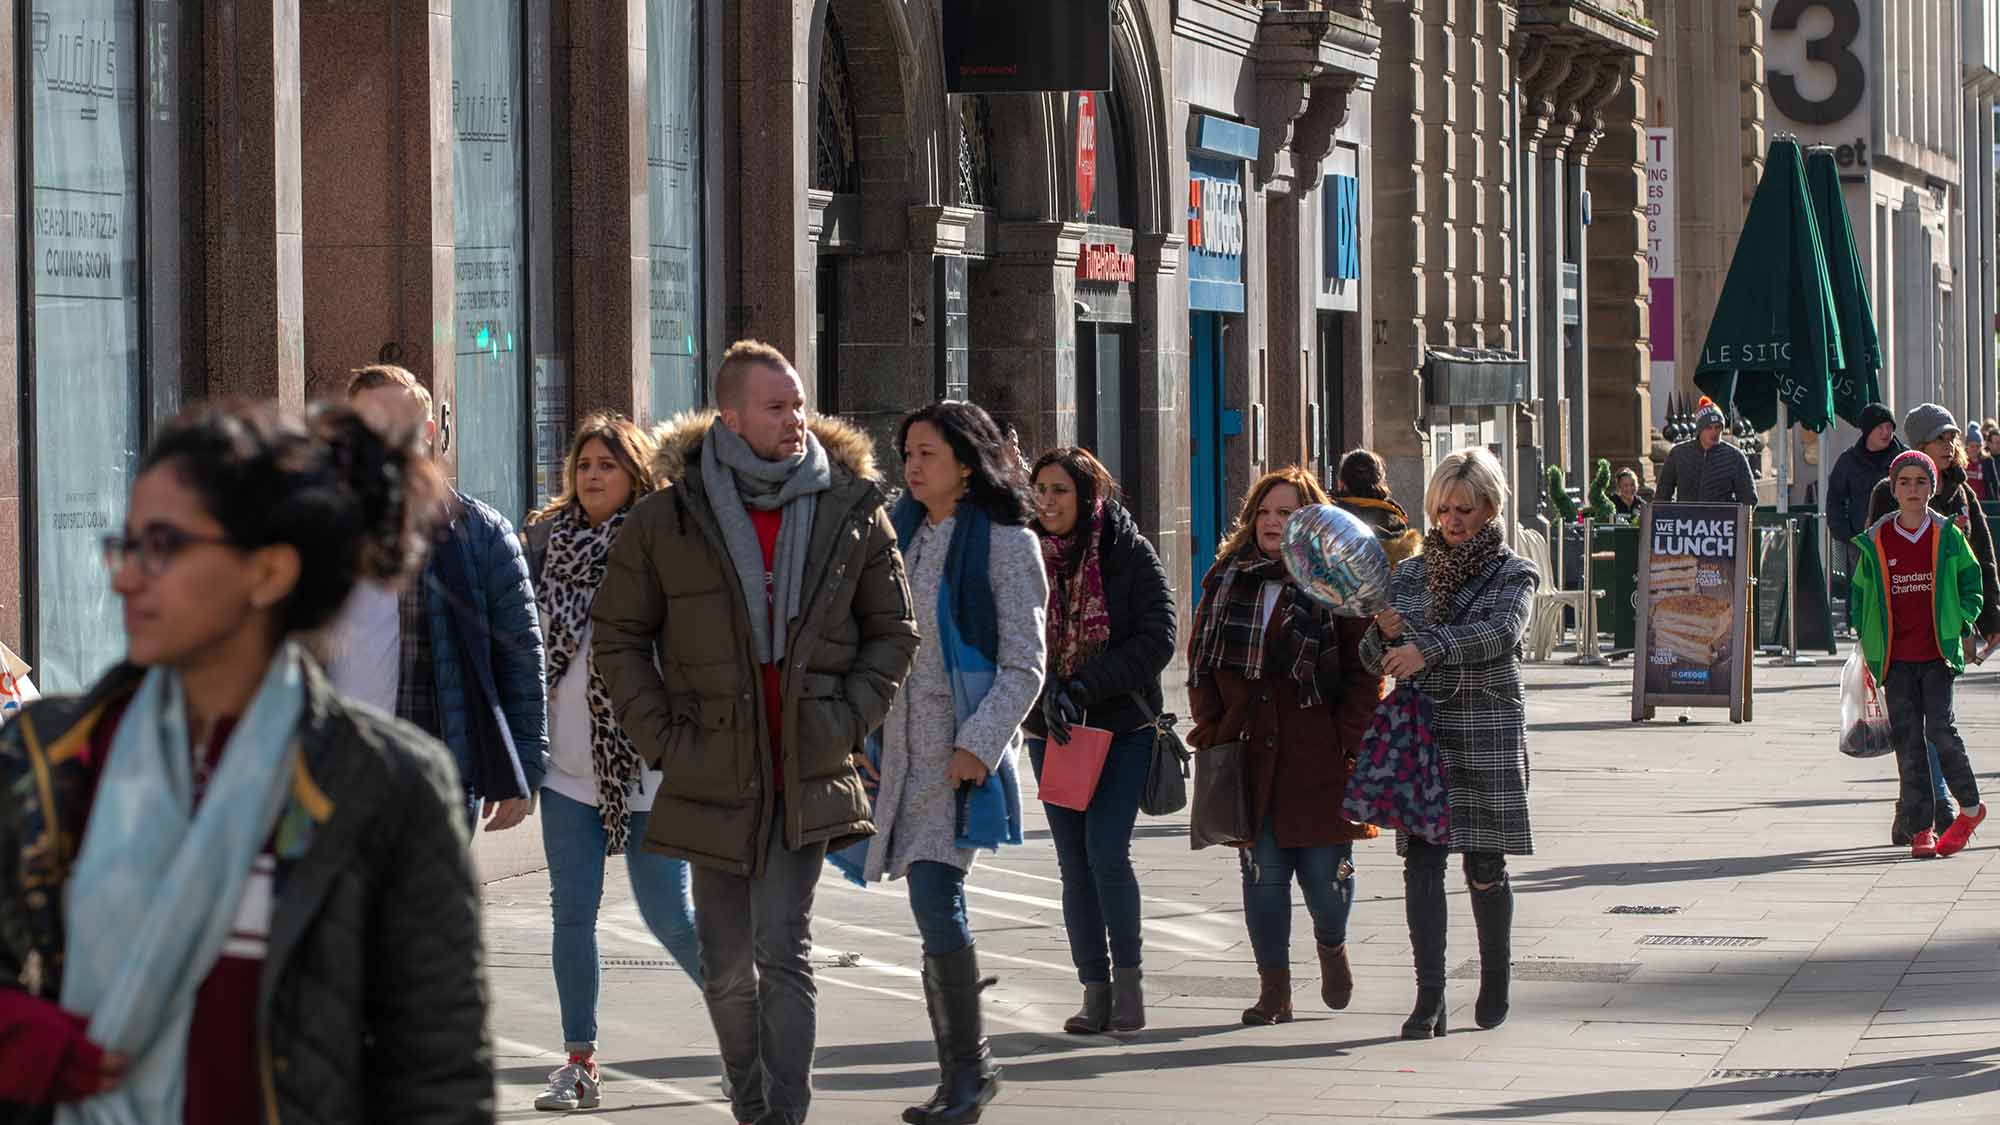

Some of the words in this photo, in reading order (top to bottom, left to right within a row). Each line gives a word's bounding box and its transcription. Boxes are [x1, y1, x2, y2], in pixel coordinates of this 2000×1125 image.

[1767, 0, 1865, 125] 3
[36, 207, 88, 241] NEAPOLITAN
[89, 210, 120, 241] PIZZA
[1202, 178, 1243, 255] GREGGS
[46, 247, 83, 278] COMING
[84, 249, 111, 279] SOON
[1706, 345, 1731, 364] LE
[1656, 522, 1674, 532] WE
[1675, 519, 1735, 537] MAKE
[1654, 536, 1735, 557] LUNCH
[1892, 573, 1932, 584] Standard
